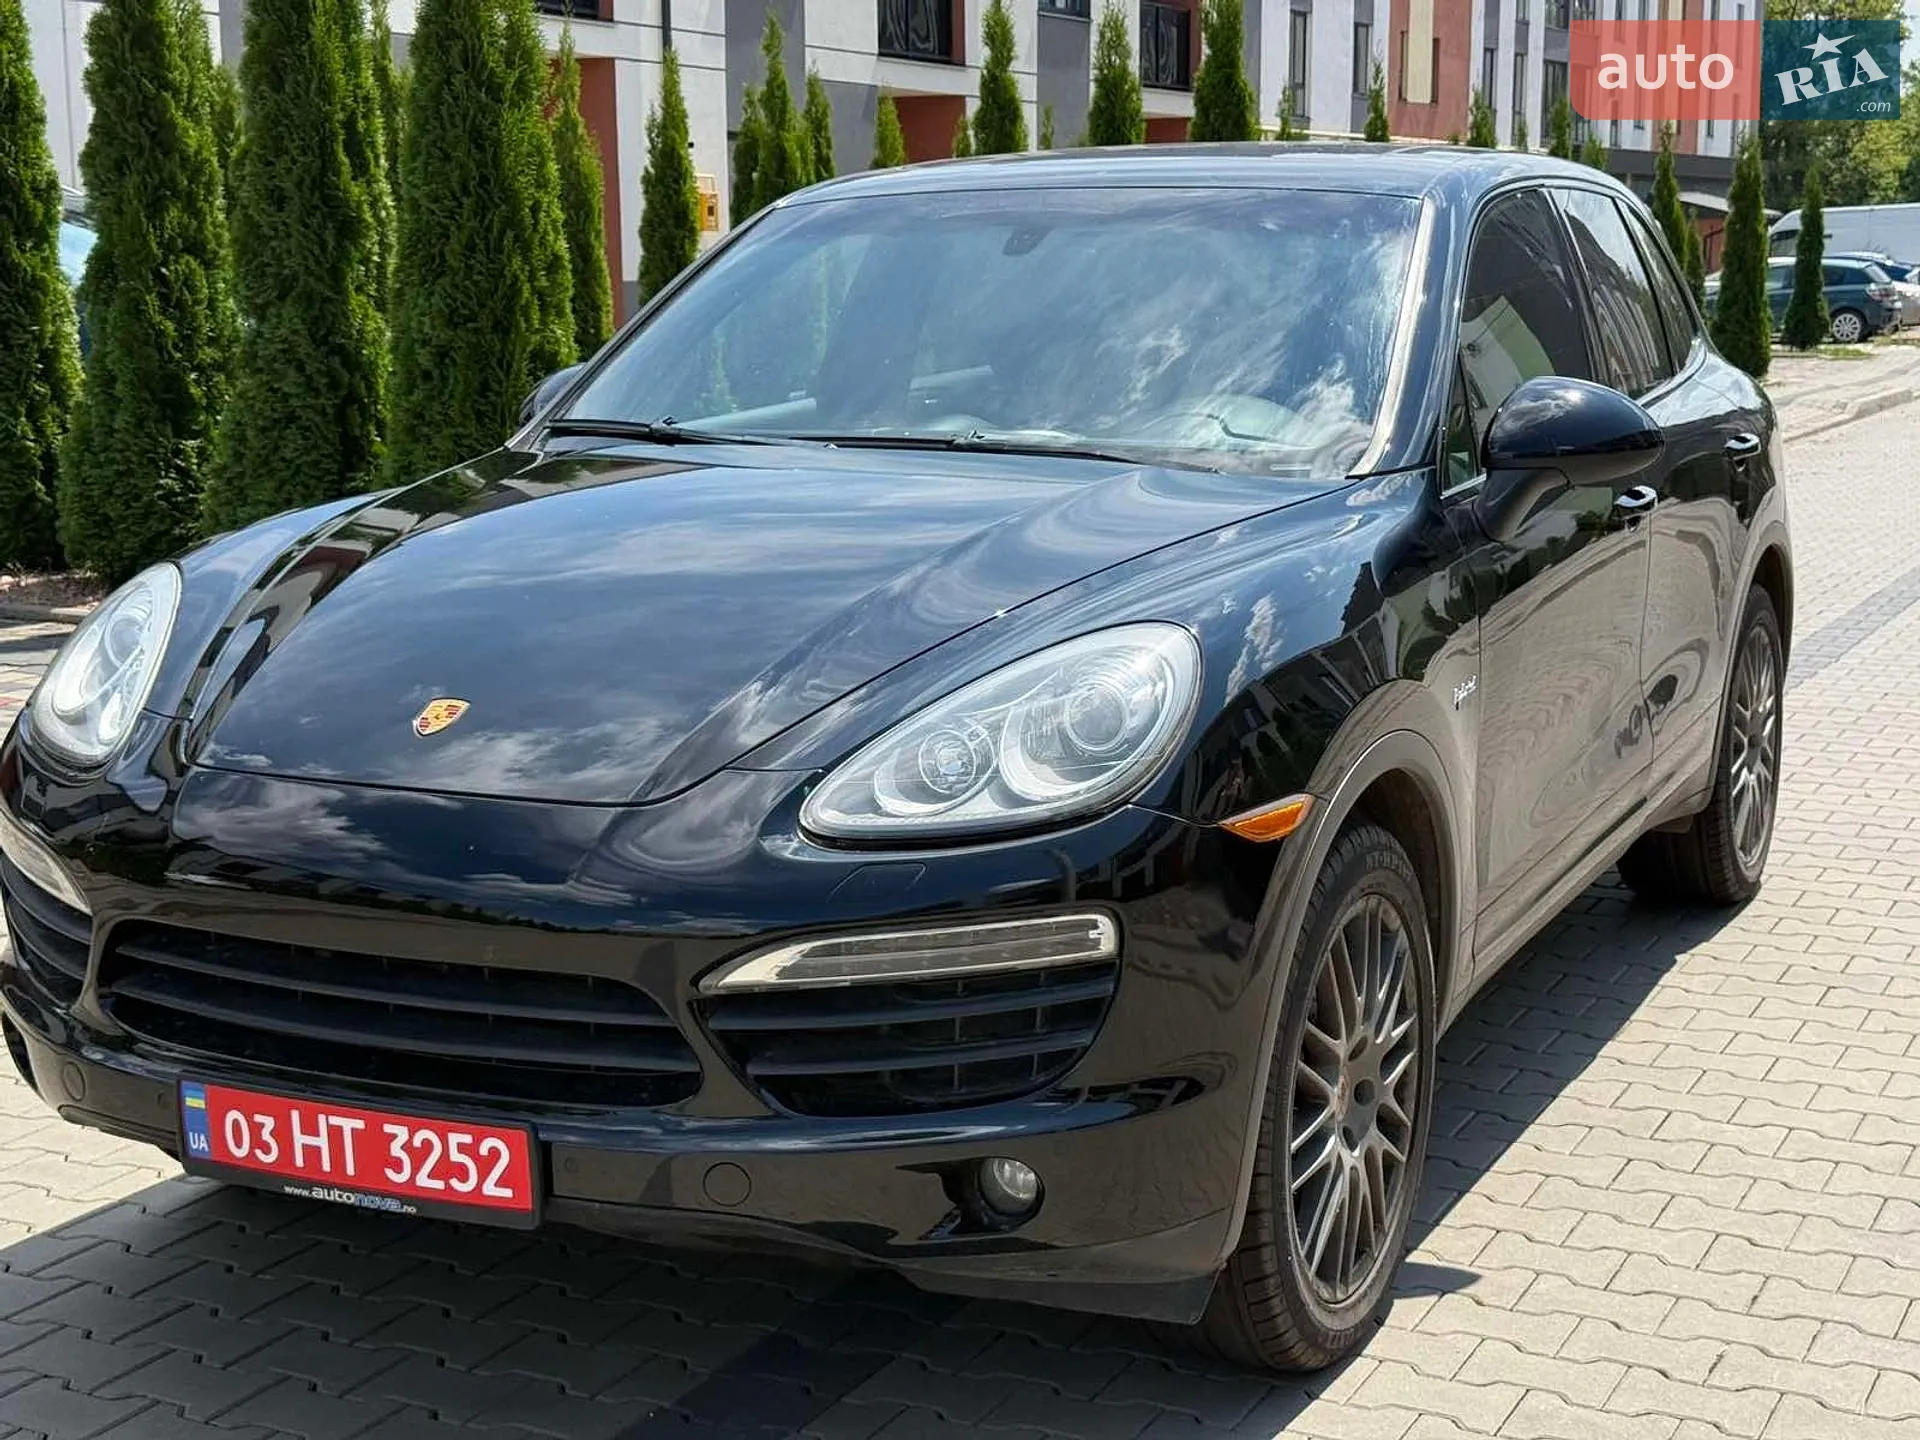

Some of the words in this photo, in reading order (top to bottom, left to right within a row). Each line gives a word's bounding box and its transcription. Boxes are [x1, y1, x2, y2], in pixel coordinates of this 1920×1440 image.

[189, 1131, 209, 1151] UA
[224, 1109, 280, 1164] 03
[290, 1109, 366, 1177] HT
[383, 1123, 514, 1199] 3252
